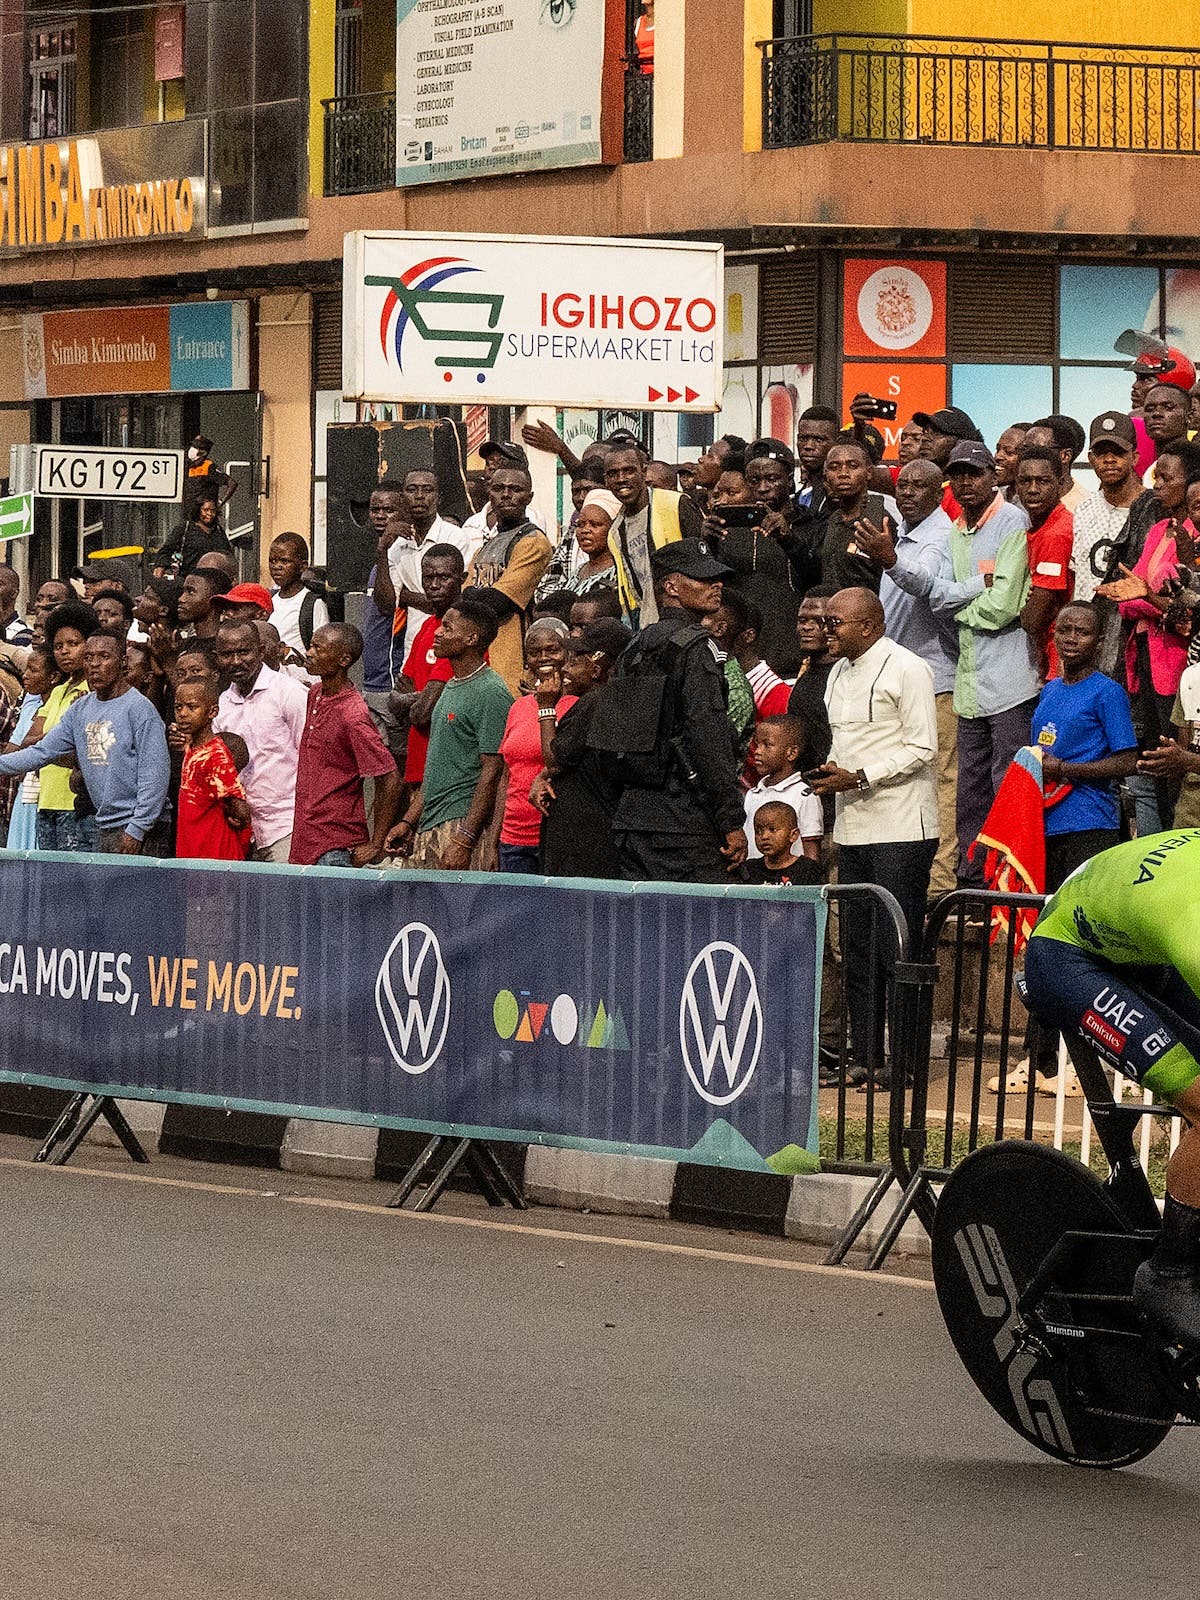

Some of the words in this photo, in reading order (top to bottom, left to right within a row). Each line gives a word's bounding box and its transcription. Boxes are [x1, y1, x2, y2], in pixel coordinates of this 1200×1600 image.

[455, 27, 473, 40] FIELD
[474, 19, 514, 37] EXAMINATION
[416, 49, 444, 62] INTERNAL
[445, 43, 474, 59] MEDICINE
[416, 65, 443, 79] GENERAL
[444, 61, 472, 75] MEDICINE
[416, 81, 454, 95] LABORATORY
[416, 97, 454, 112] GYNECOLOGY
[461, 136, 487, 151] Britam
[0, 140, 88, 247] IMBA
[88, 177, 194, 241] KIMIRONKO
[541, 292, 717, 333] IGIHOZO
[51, 338, 89, 366] Simba
[91, 335, 157, 364] Kimironko
[176, 336, 226, 360] Entrance
[507, 333, 673, 362] SUPERMARKET
[679, 339, 716, 363] Ltd
[151, 460, 171, 476] ST
[35, 946, 140, 1016] MOVES,
[147, 954, 199, 1010] WE
[205, 959, 303, 1021] MOVE.
[1092, 986, 1145, 1036] UAE
[1085, 1014, 1121, 1048] Emirates
[1045, 1324, 1085, 1338] SHIMANO
